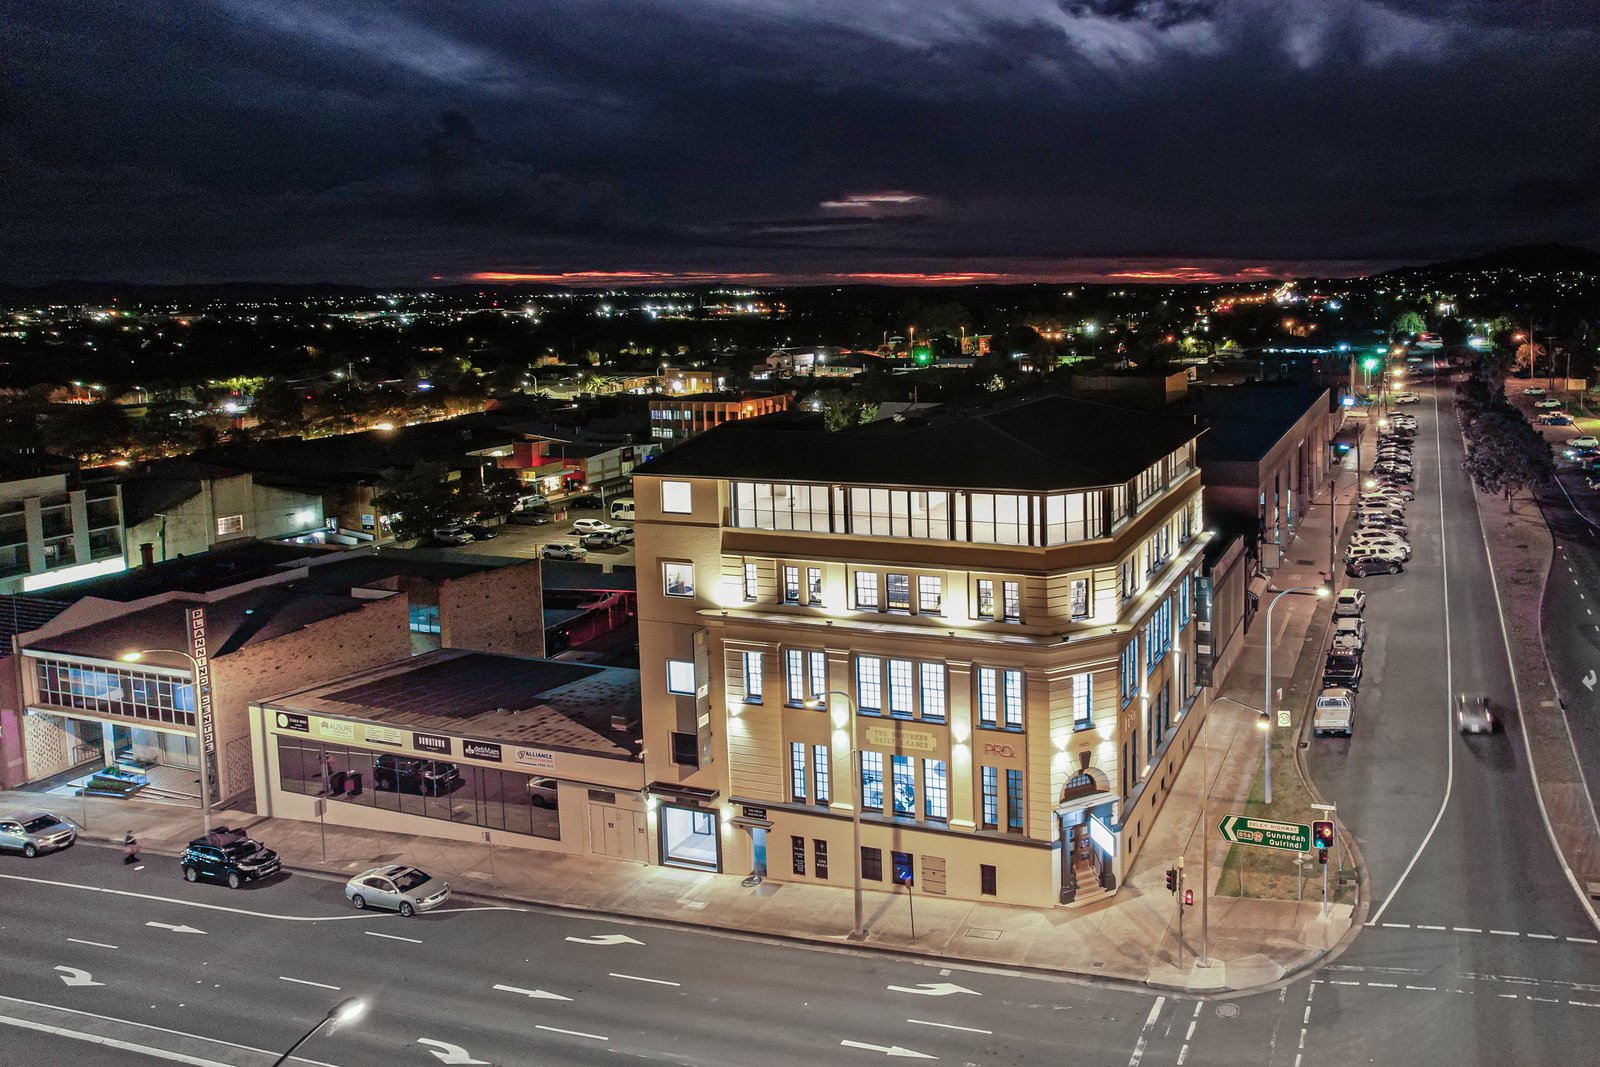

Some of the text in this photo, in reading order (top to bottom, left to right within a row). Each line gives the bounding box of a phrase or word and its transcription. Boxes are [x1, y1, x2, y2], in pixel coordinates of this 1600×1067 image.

[194, 611, 207, 684] PLANNING
[330, 723, 352, 732] AUSURE
[525, 751, 552, 759] ALLIANCE
[1266, 831, 1306, 842] Gunnedah
[1269, 839, 1302, 849] Quirindi
